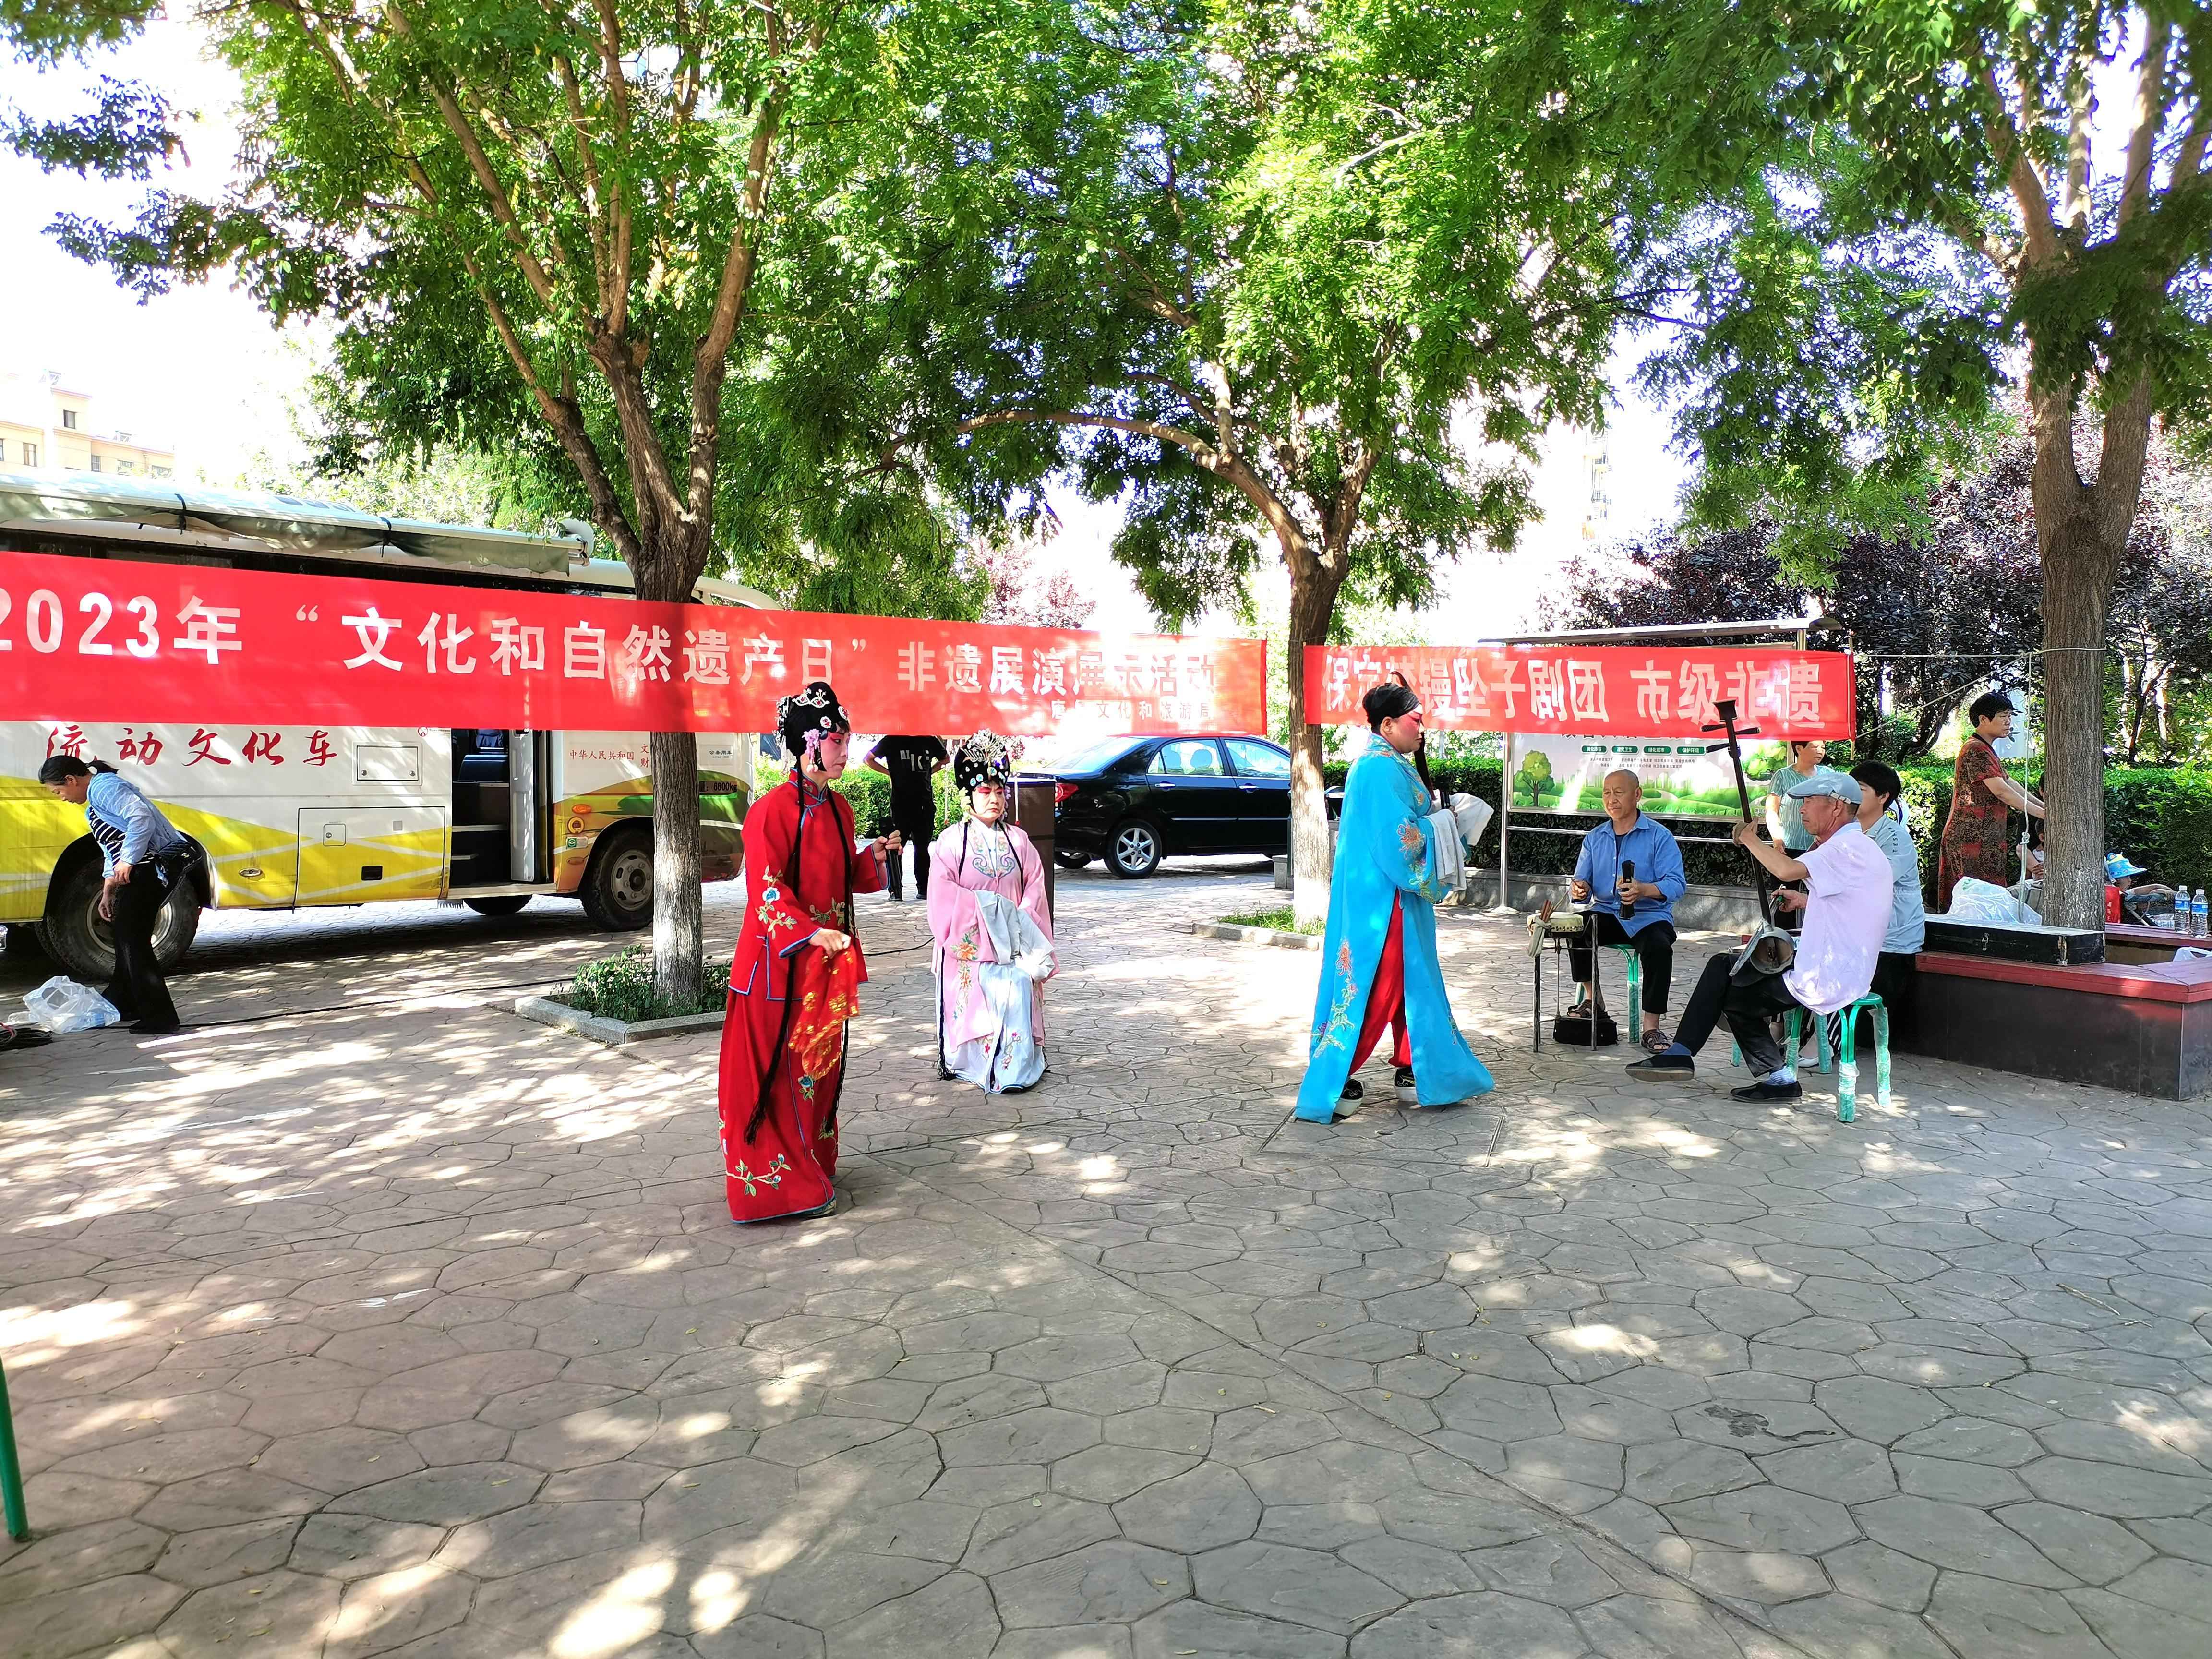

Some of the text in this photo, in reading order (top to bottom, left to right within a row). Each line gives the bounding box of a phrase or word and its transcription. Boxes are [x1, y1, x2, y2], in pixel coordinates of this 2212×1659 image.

[1051, 699, 1210, 720] 唐文化和旅游局
[1630, 660, 1825, 729] 市级非遗
[45, 724, 338, 766] 流动文化车
[570, 750, 634, 760] 中华人民共和国
